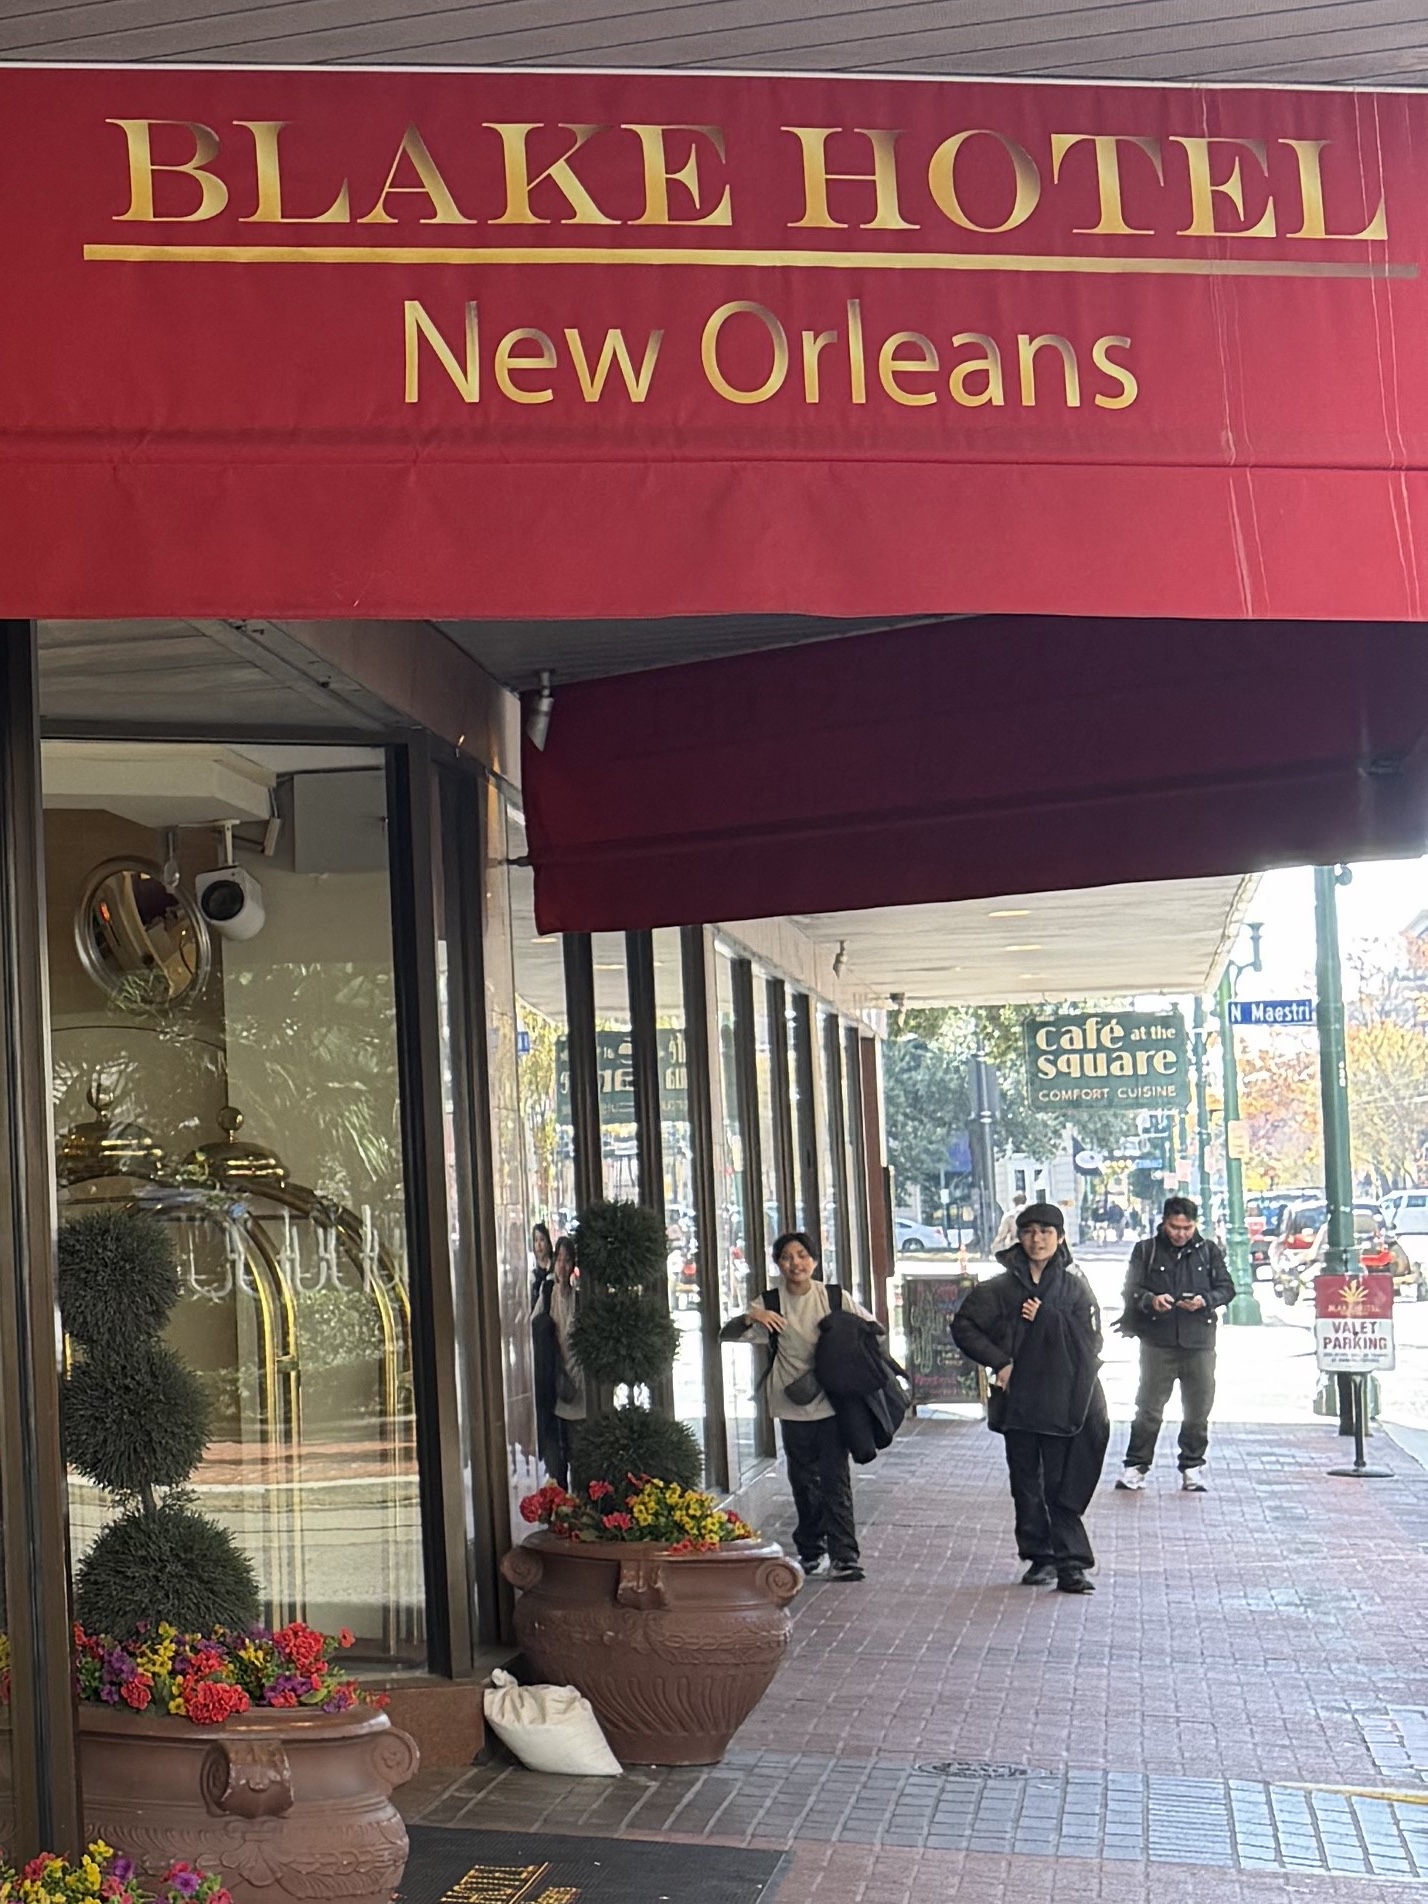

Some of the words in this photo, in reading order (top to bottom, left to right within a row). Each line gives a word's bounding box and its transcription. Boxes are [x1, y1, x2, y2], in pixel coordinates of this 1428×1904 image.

[104, 116, 733, 228] BLAKE
[779, 124, 1389, 243] HOTEL
[401, 298, 664, 405] New
[700, 298, 1139, 411] Orleans
[1230, 1003, 1242, 1022] N
[1251, 1001, 1310, 1022] Maestri
[1035, 1017, 1125, 1051] café
[1130, 1026, 1147, 1041] at
[1150, 1025, 1176, 1040] the
[1037, 1049, 1178, 1080] square
[1038, 1087, 1110, 1102] COMFORT
[1117, 1085, 1177, 1099] CUISINE
[1332, 1321, 1378, 1335] VALET
[1323, 1336, 1388, 1350] PARKING
